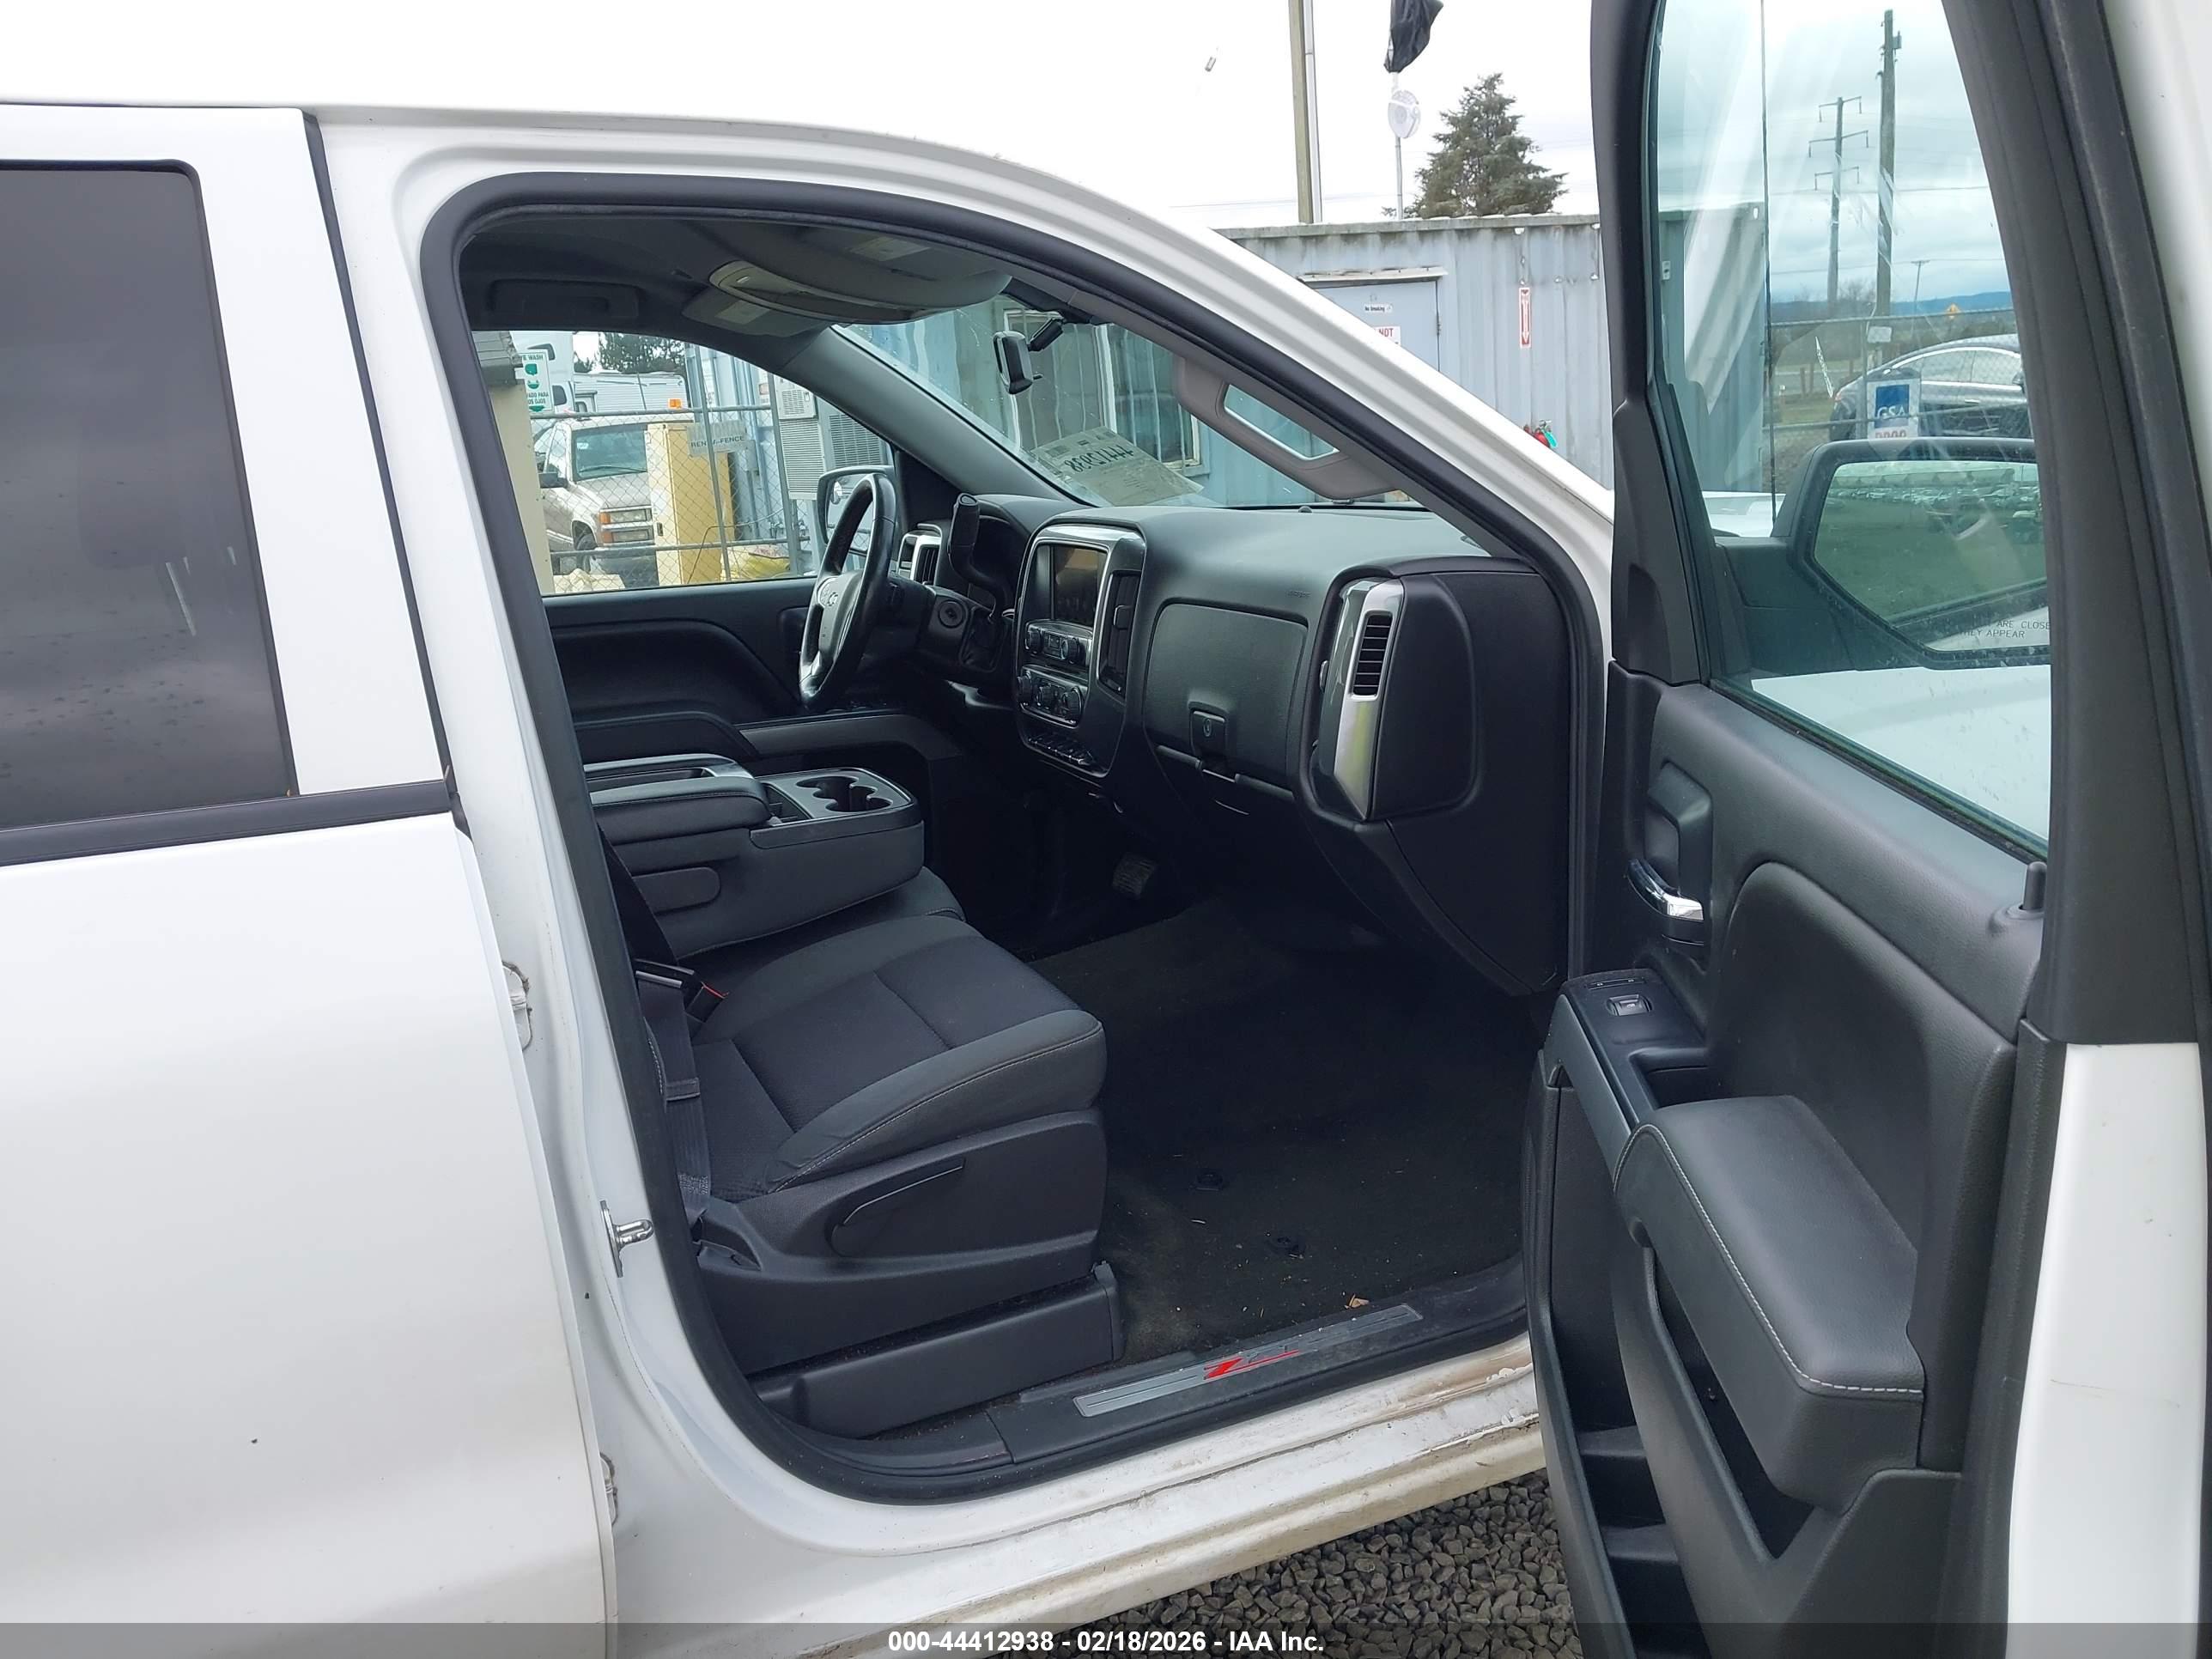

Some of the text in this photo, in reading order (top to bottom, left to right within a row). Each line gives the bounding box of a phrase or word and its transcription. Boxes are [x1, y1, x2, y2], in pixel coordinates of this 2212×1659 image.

[1877, 404, 1907, 420] GSA
[1996, 620, 2014, 629] ARE
[1986, 629, 2026, 639] APPEAR
